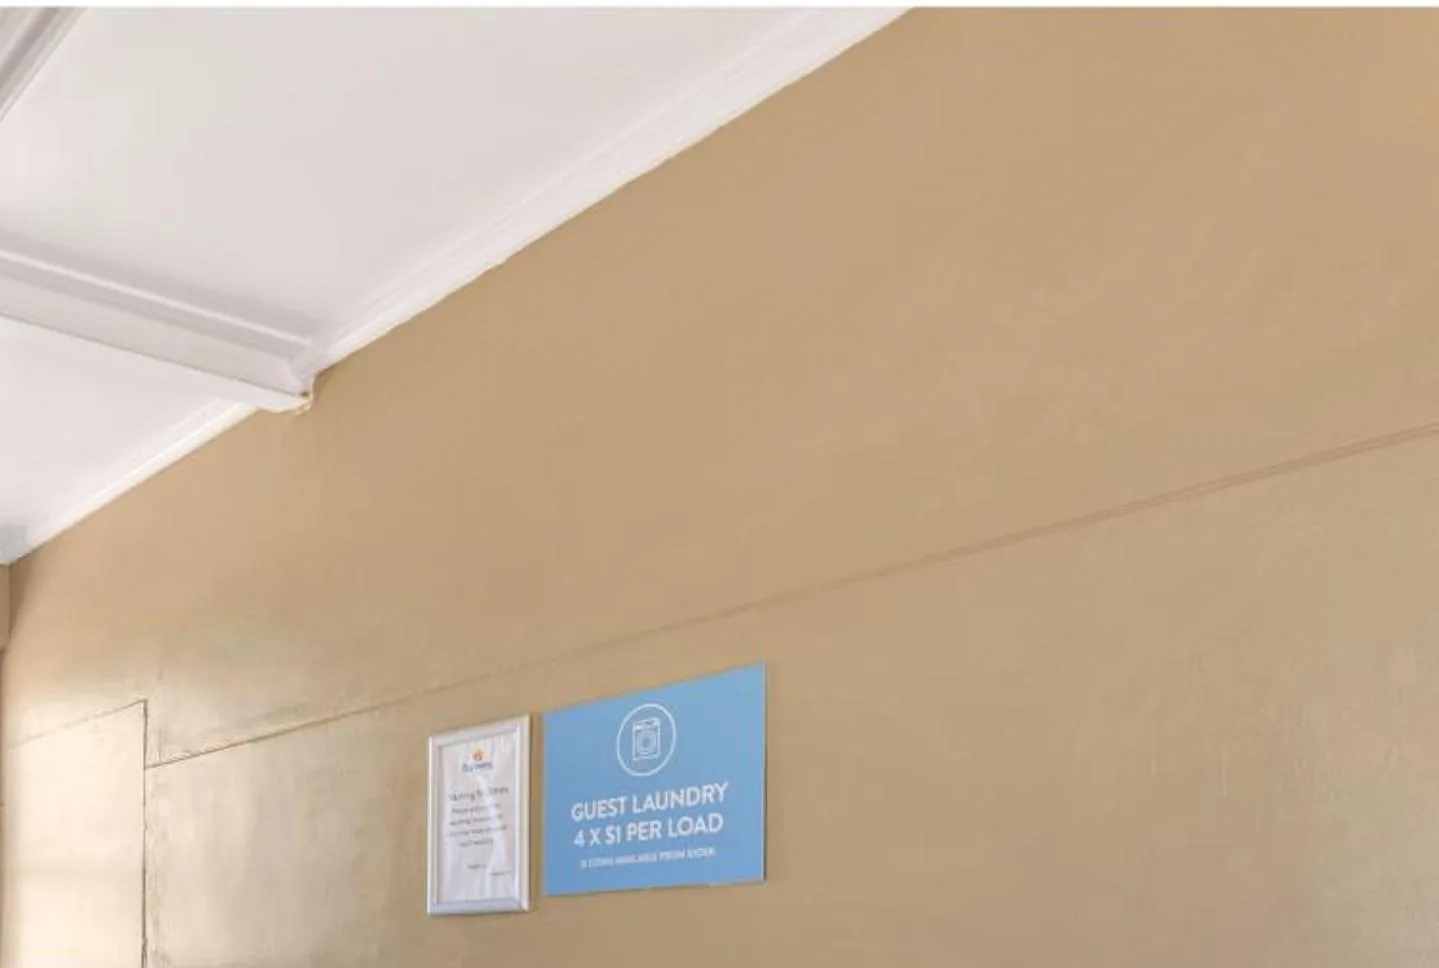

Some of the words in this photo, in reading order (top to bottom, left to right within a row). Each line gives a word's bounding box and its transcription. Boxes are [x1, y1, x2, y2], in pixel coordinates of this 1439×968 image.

[571, 796, 627, 822] GUEST
[632, 781, 729, 814] LAUNDRY
[573, 828, 586, 848] 4
[589, 826, 603, 847] X
[625, 819, 663, 842] PER
[668, 812, 724, 838] LOAD
